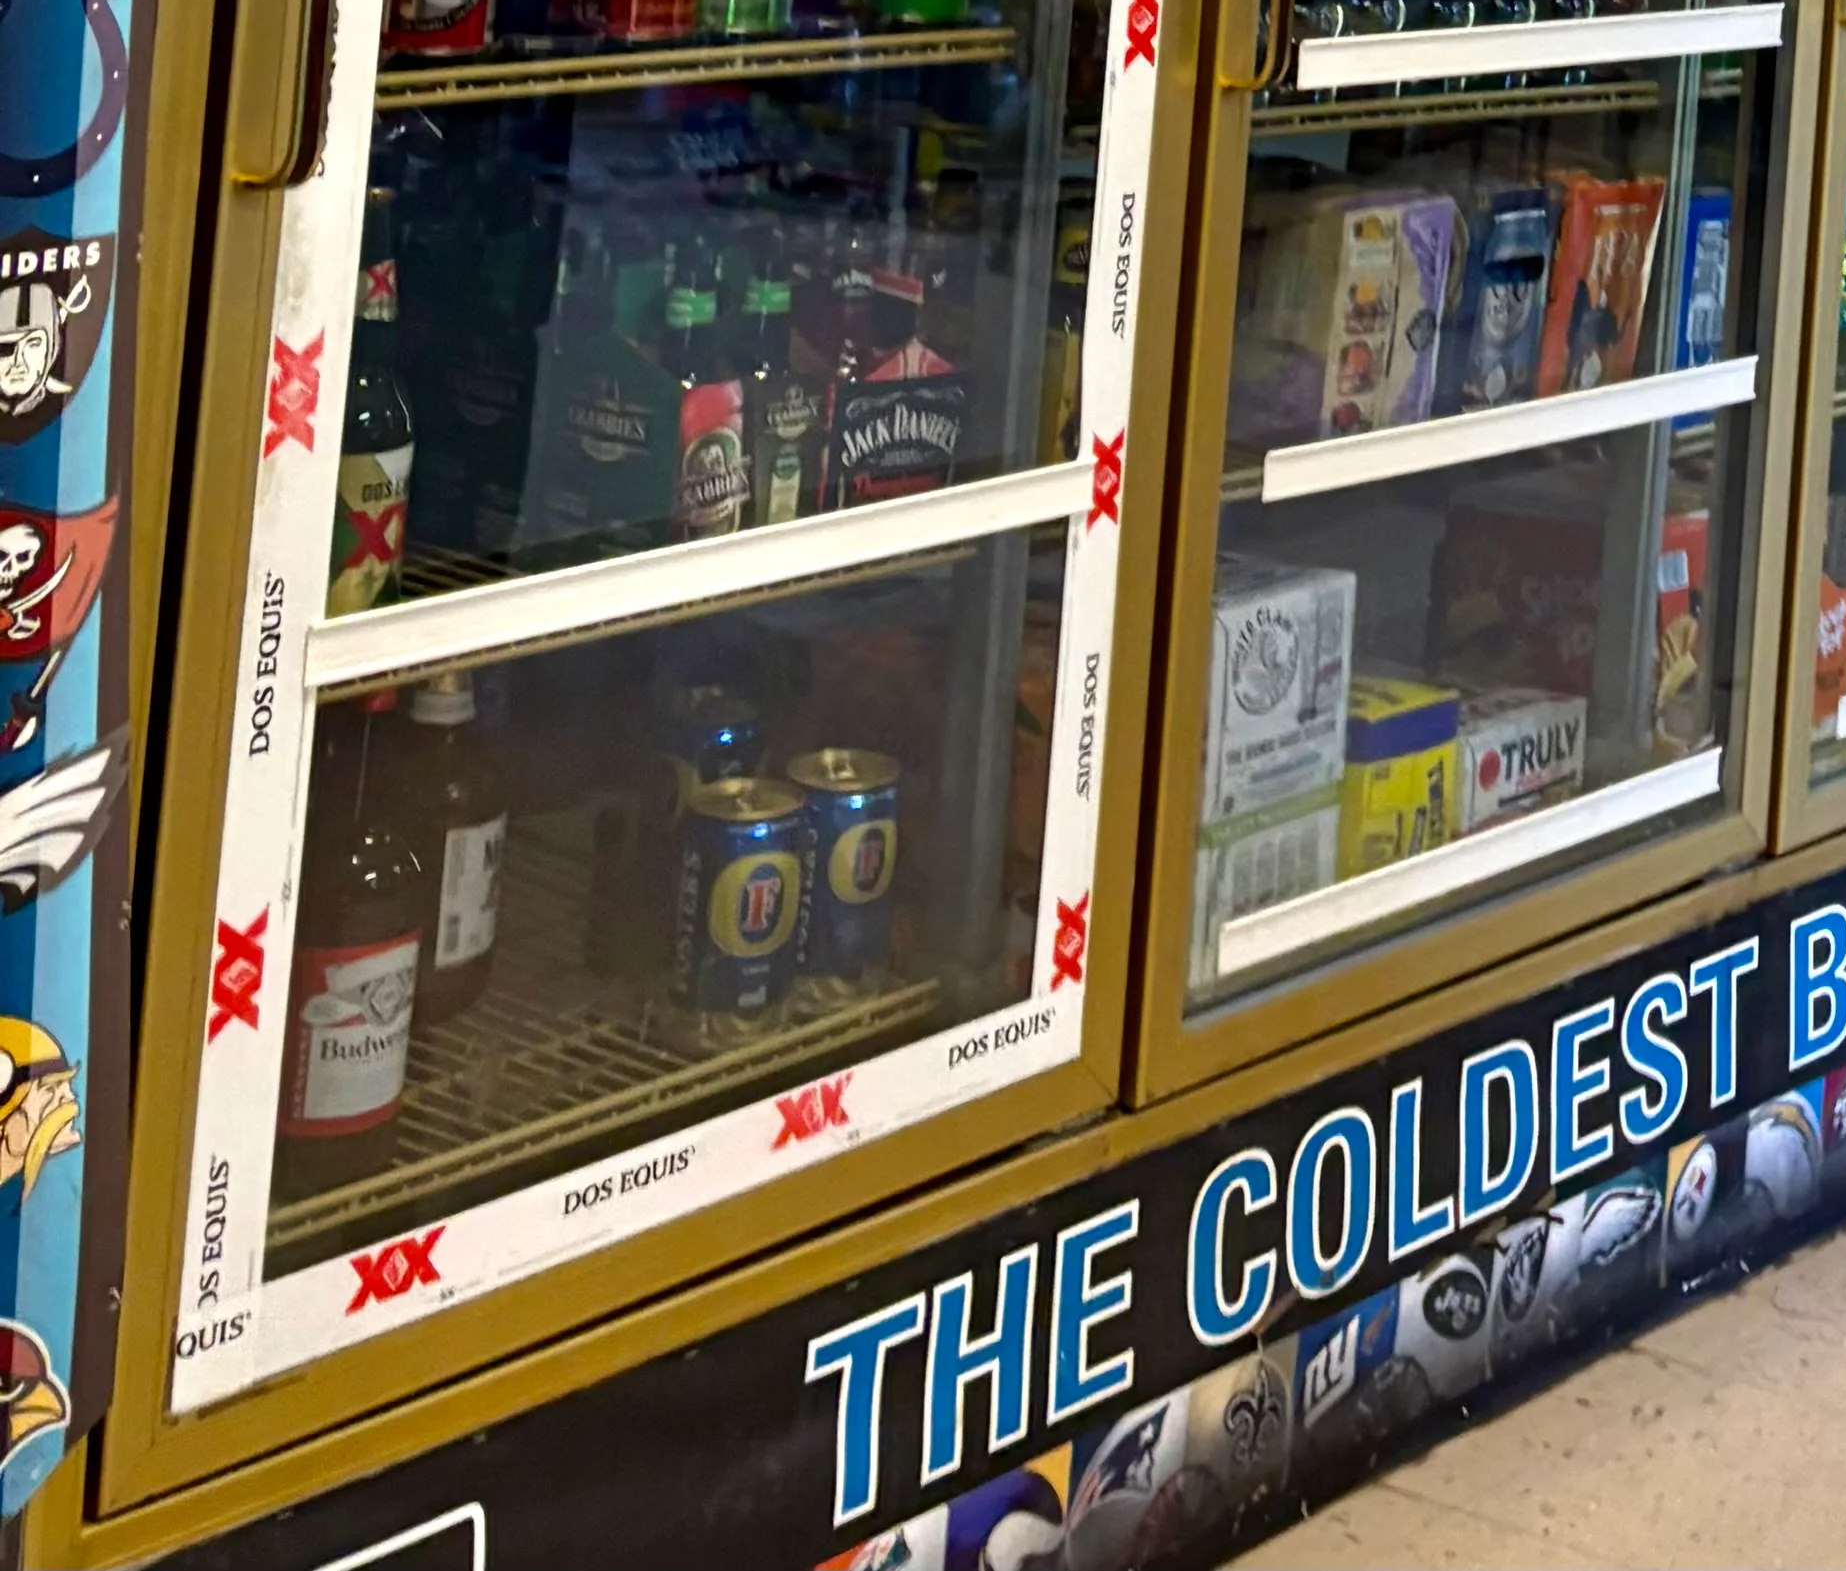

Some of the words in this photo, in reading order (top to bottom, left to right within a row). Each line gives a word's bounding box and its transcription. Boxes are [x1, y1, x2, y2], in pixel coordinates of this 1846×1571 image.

[1120, 192, 1135, 251] DOS
[1111, 254, 1131, 336] EQUIS
[842, 418, 891, 466] JACK
[256, 572, 285, 680] EQUIS
[1083, 654, 1101, 710] DOS
[250, 686, 274, 756] DOS
[1501, 716, 1580, 782] TRULY
[1077, 713, 1097, 799] EQUIS
[947, 1034, 990, 1067] DOS
[994, 1010, 1056, 1052] EQUIS
[203, 1156, 230, 1264] EQUIS
[562, 1180, 613, 1216] DOS
[619, 1148, 695, 1195] EQUIS
[805, 1199, 1140, 1530] THE
[1188, 935, 1758, 1348] COLDEST
